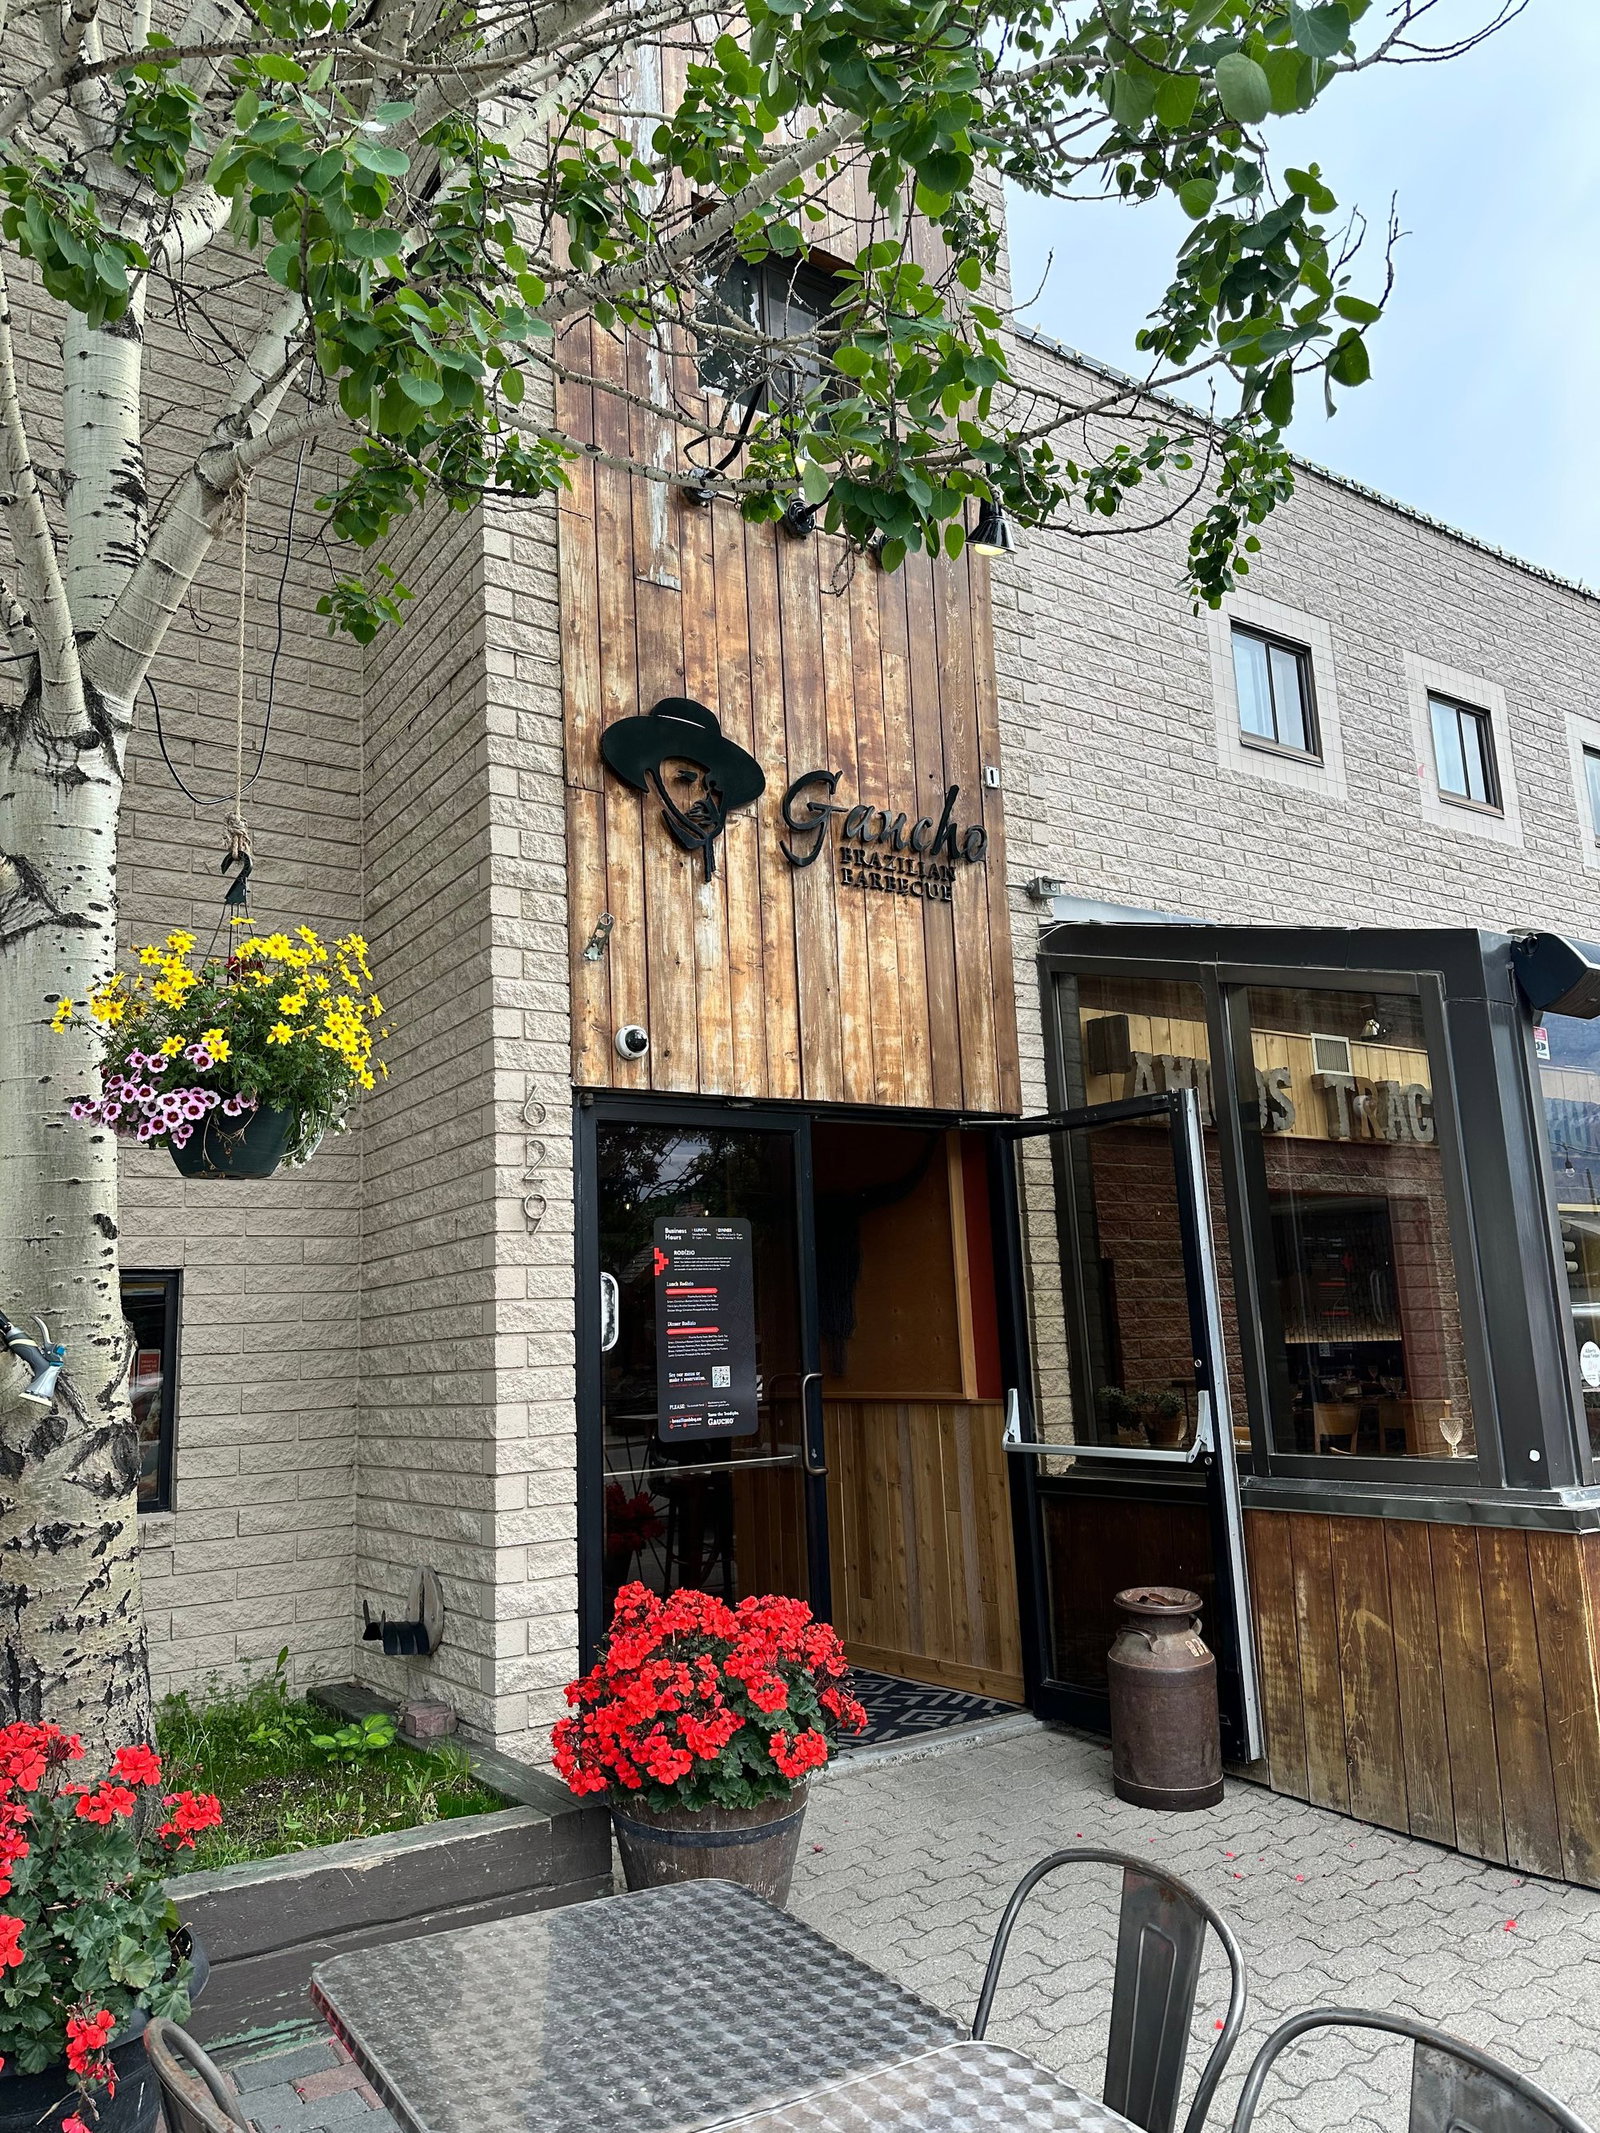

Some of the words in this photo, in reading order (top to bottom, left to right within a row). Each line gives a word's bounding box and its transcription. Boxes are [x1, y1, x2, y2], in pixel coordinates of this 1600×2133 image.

[779, 770, 988, 867] Gaucho
[841, 847, 956, 882] BRAZILIAN
[523, 1084, 547, 1235] 629
